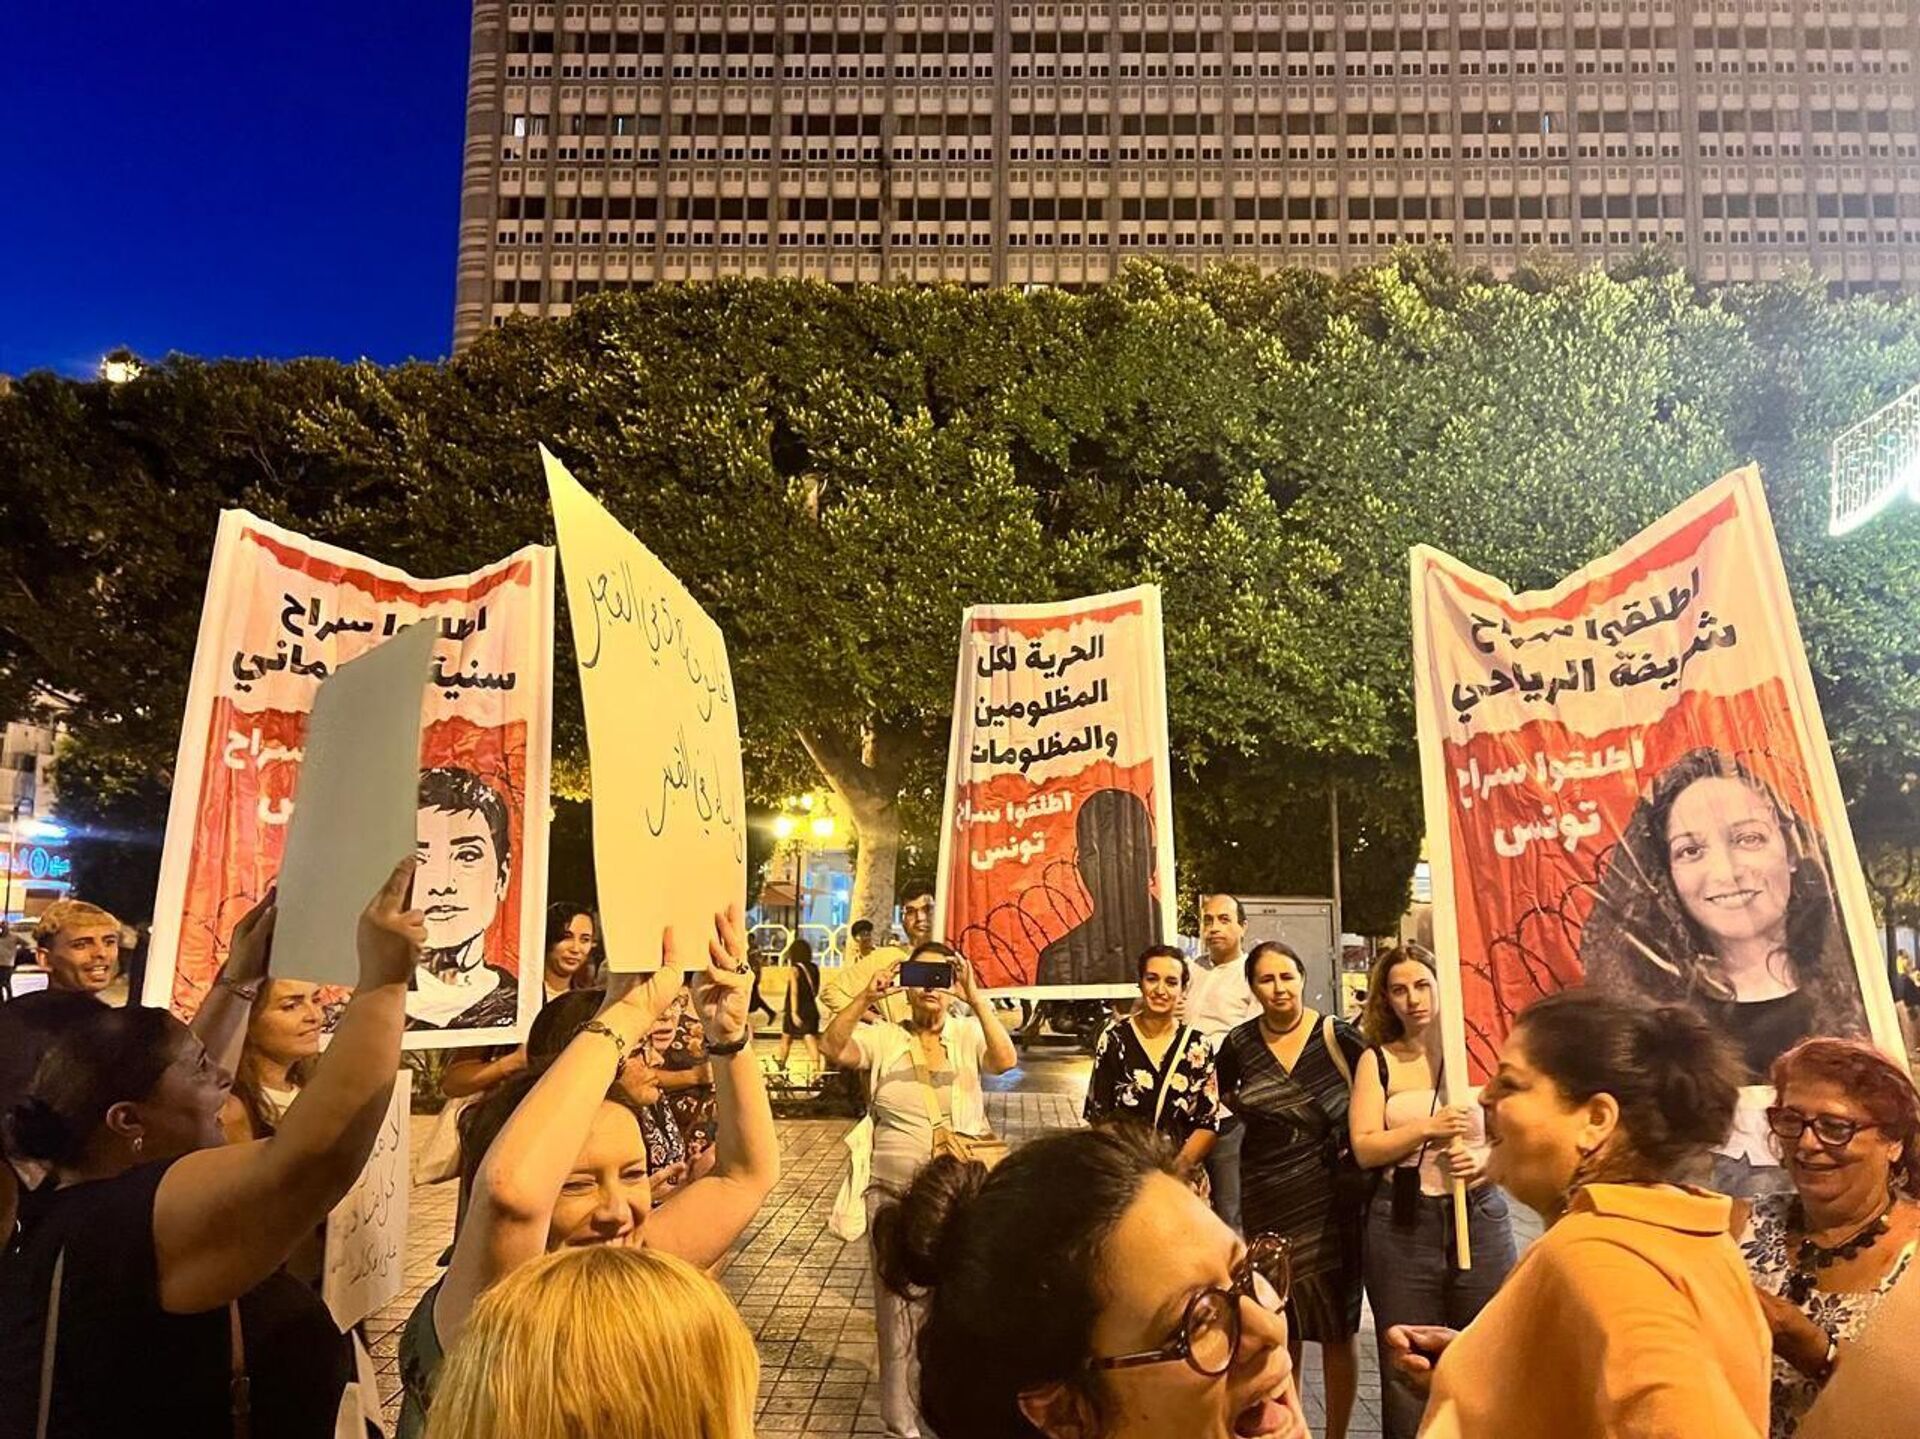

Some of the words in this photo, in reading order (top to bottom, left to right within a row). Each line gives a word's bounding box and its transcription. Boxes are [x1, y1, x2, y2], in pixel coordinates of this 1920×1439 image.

[281, 593, 373, 641] سراح
[977, 645, 1017, 678] لكل
[1025, 635, 1104, 679] الحرية
[1609, 609, 1737, 690] شريفة
[974, 678, 1108, 727] المظلومين
[1451, 657, 1596, 724] الرياحي
[1534, 739, 1645, 792] اطلقوا
[1007, 790, 1074, 828] اطلقوا
[1494, 800, 1600, 857] تونس
[971, 831, 1047, 870] تونس
